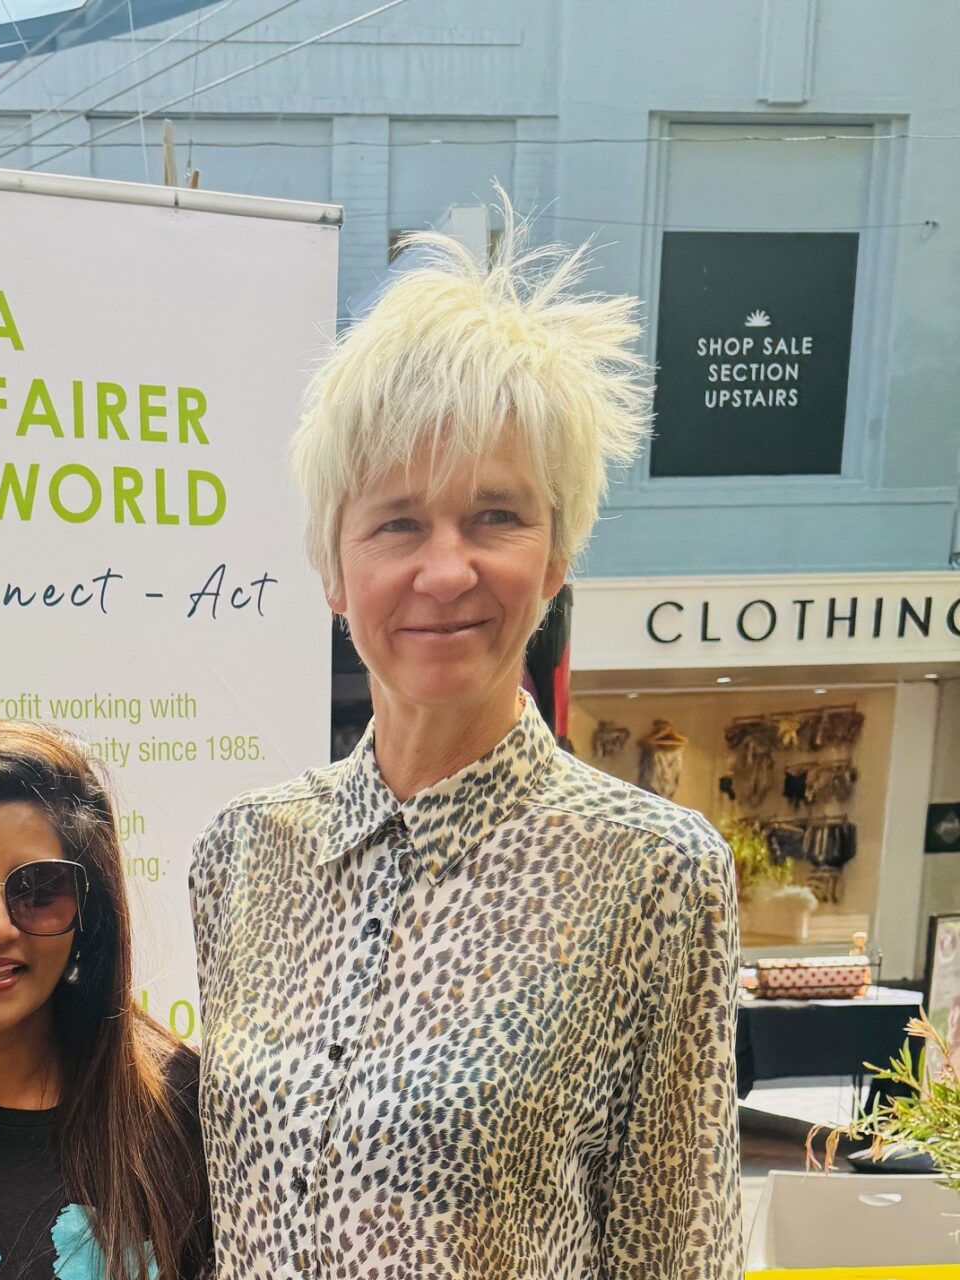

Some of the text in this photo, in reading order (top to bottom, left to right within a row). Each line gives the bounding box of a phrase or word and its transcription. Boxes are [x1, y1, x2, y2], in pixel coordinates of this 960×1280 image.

[696, 336, 813, 356] SHOP SALE
[708, 363, 799, 382] SECTION
[704, 388, 798, 408] UPSTAIRS
[187, 563, 279, 619] Act
[49, 693, 141, 724] working
[150, 693, 197, 718] with
[138, 736, 198, 762] since
[206, 735, 266, 761] 1985.
